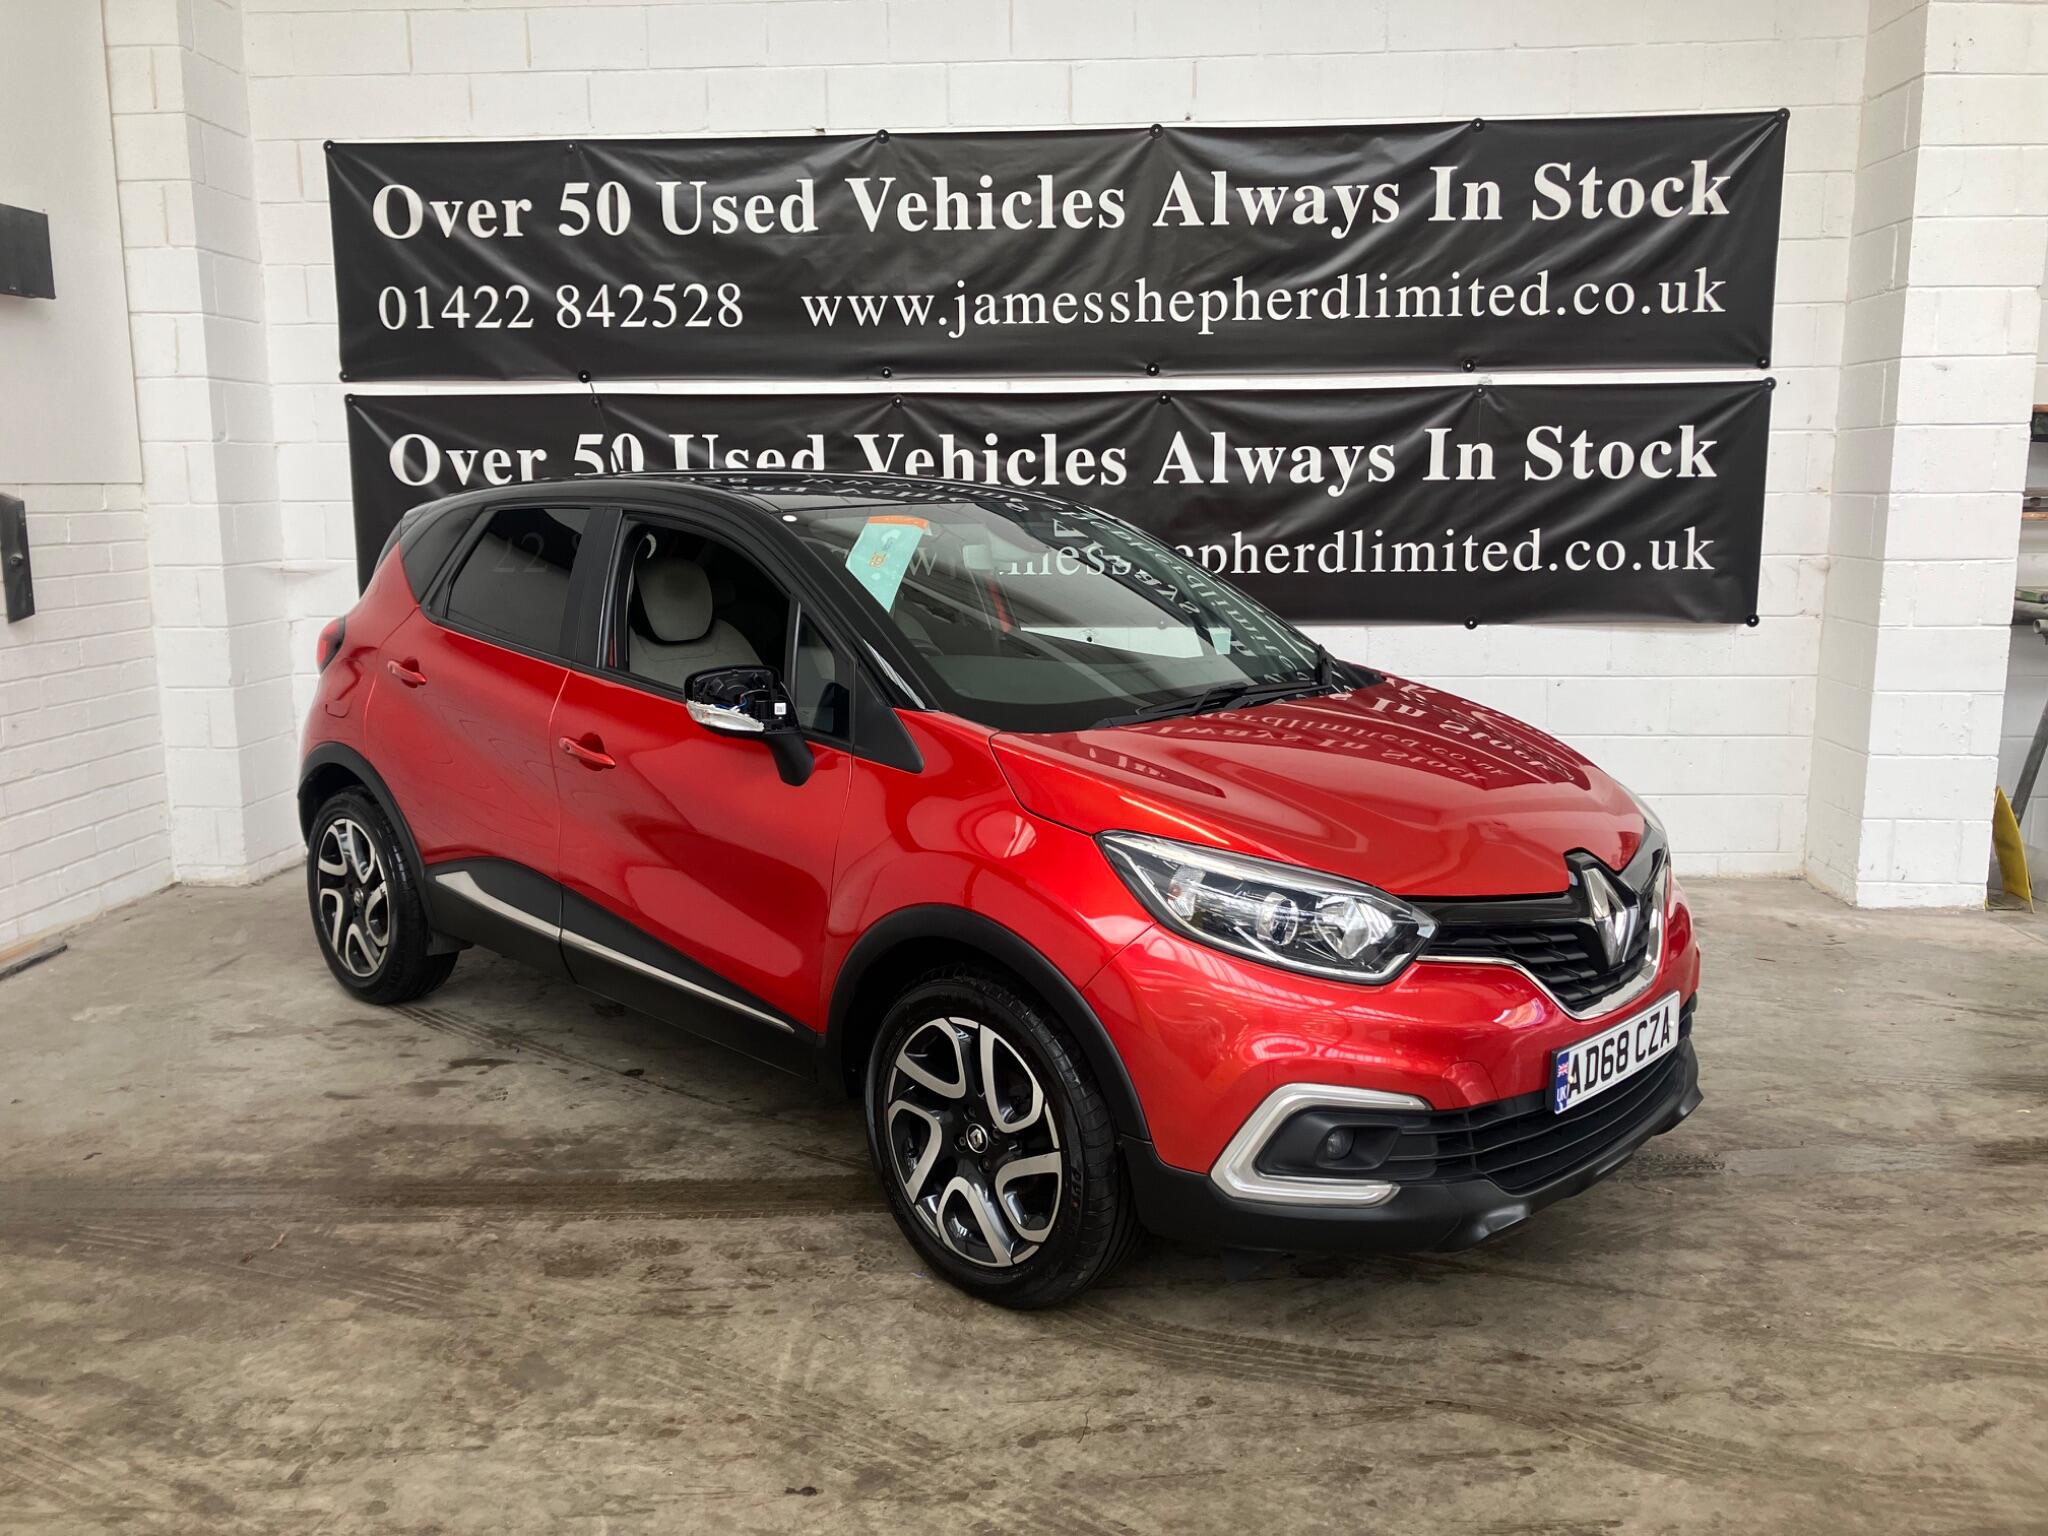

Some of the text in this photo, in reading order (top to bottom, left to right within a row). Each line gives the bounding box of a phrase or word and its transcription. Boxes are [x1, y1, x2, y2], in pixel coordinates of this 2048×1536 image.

[372, 160, 1730, 240] Over 50 Used Vehicles Always In Stock
[378, 266, 1727, 339] 01422 842528 www.jamesshepherdlimited.co.uk
[389, 424, 1718, 498] Over 50 Used Vehicles Always In Stock
[1569, 1006, 1671, 1096] AD68 CZA
